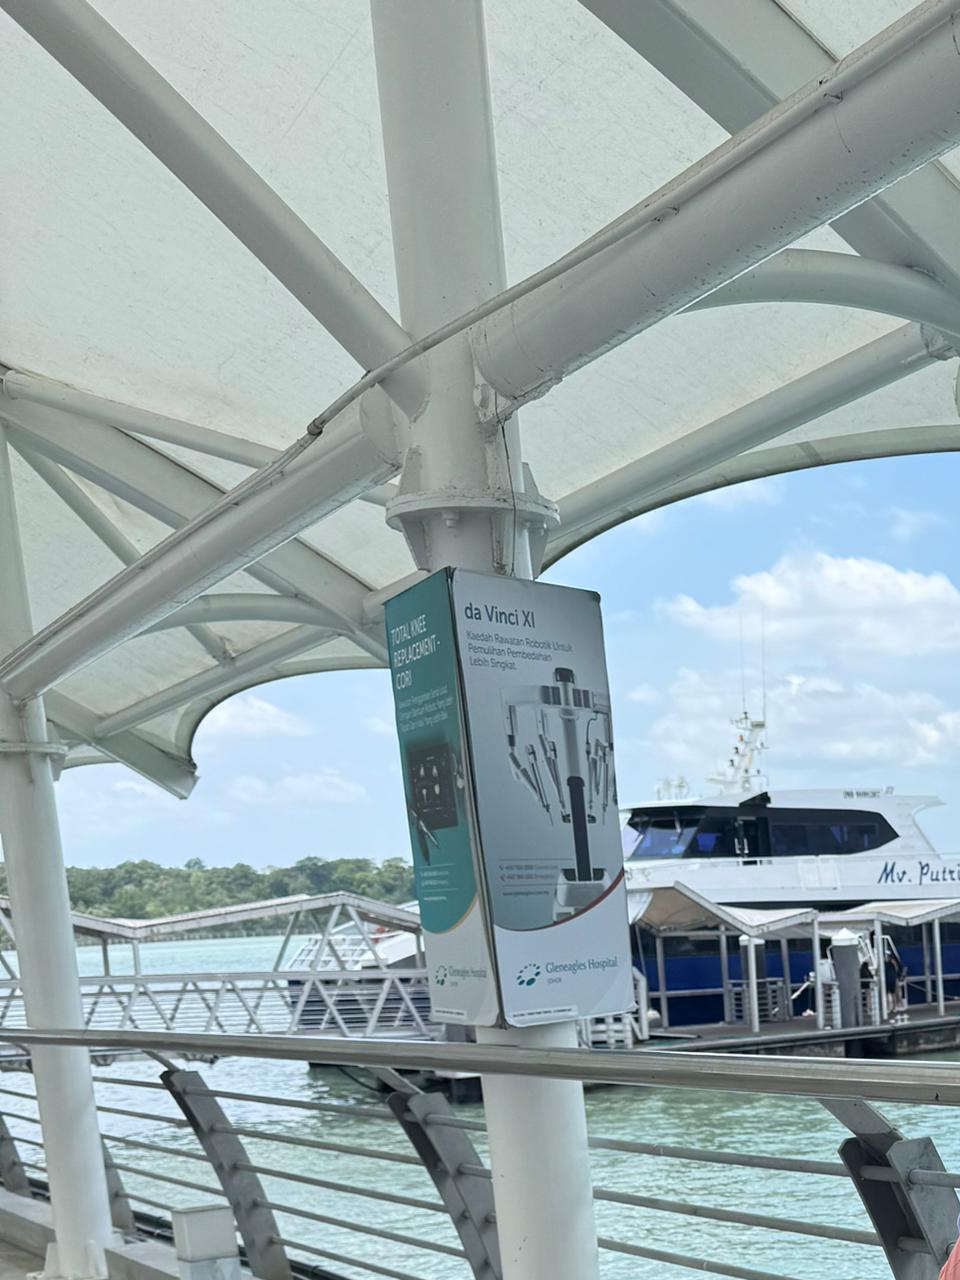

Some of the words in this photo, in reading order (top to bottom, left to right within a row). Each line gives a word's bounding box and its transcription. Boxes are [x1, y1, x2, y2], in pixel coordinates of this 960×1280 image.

[464, 602, 481, 621] da
[484, 604, 519, 626] Vinci
[522, 610, 536, 628] XI
[391, 623, 411, 646] TOTAL
[411, 614, 427, 637] KNEE
[466, 630, 493, 642] Kaedah
[495, 634, 524, 646] Rawatan
[526, 638, 551, 650] Robotik
[552, 641, 573, 653] Untuk
[468, 643, 506, 657] Pemulihan
[507, 647, 552, 662] Pembedahan
[469, 656, 489, 667] Lebih
[877, 861, 912, 884] Mv.
[545, 961, 588, 976] Gleneagles
[588, 956, 618, 971] Hospital
